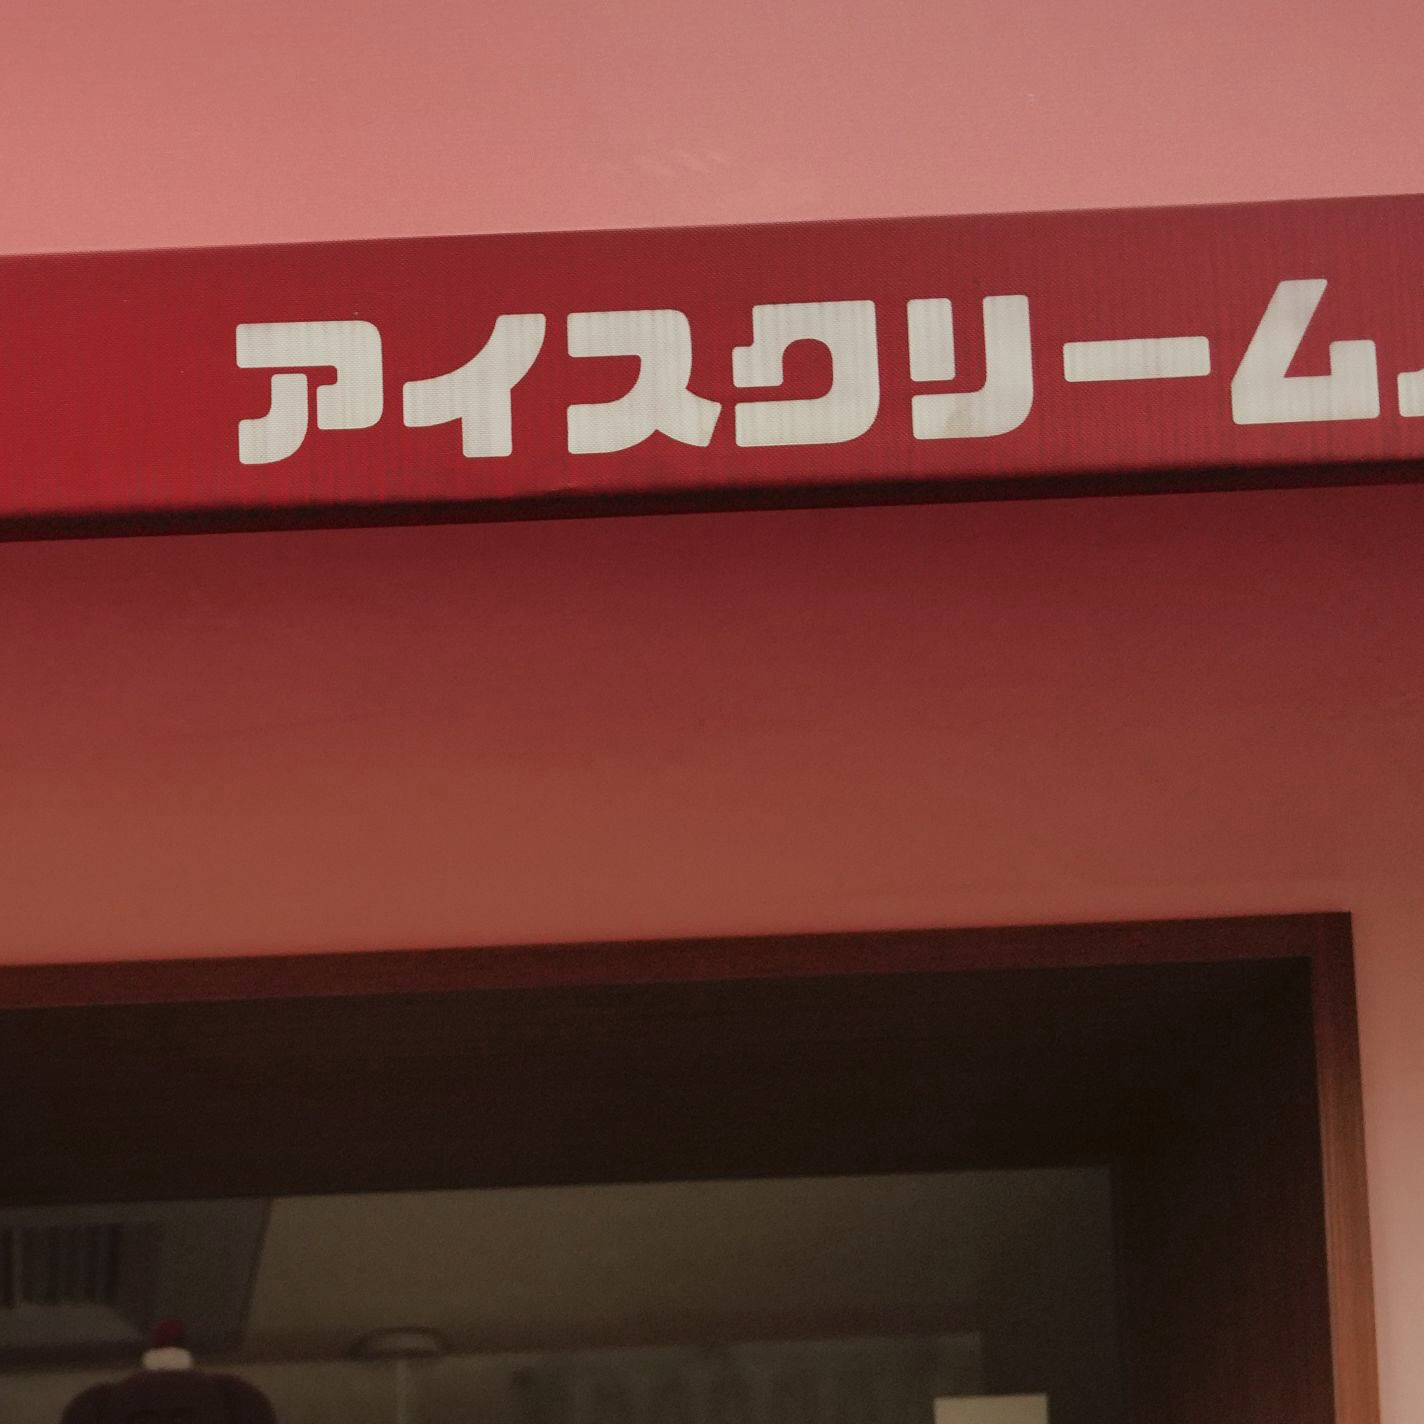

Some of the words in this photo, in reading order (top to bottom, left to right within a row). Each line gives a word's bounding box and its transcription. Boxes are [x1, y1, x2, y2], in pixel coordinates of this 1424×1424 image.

[236, 278, 1424, 465] アイスクリーム
